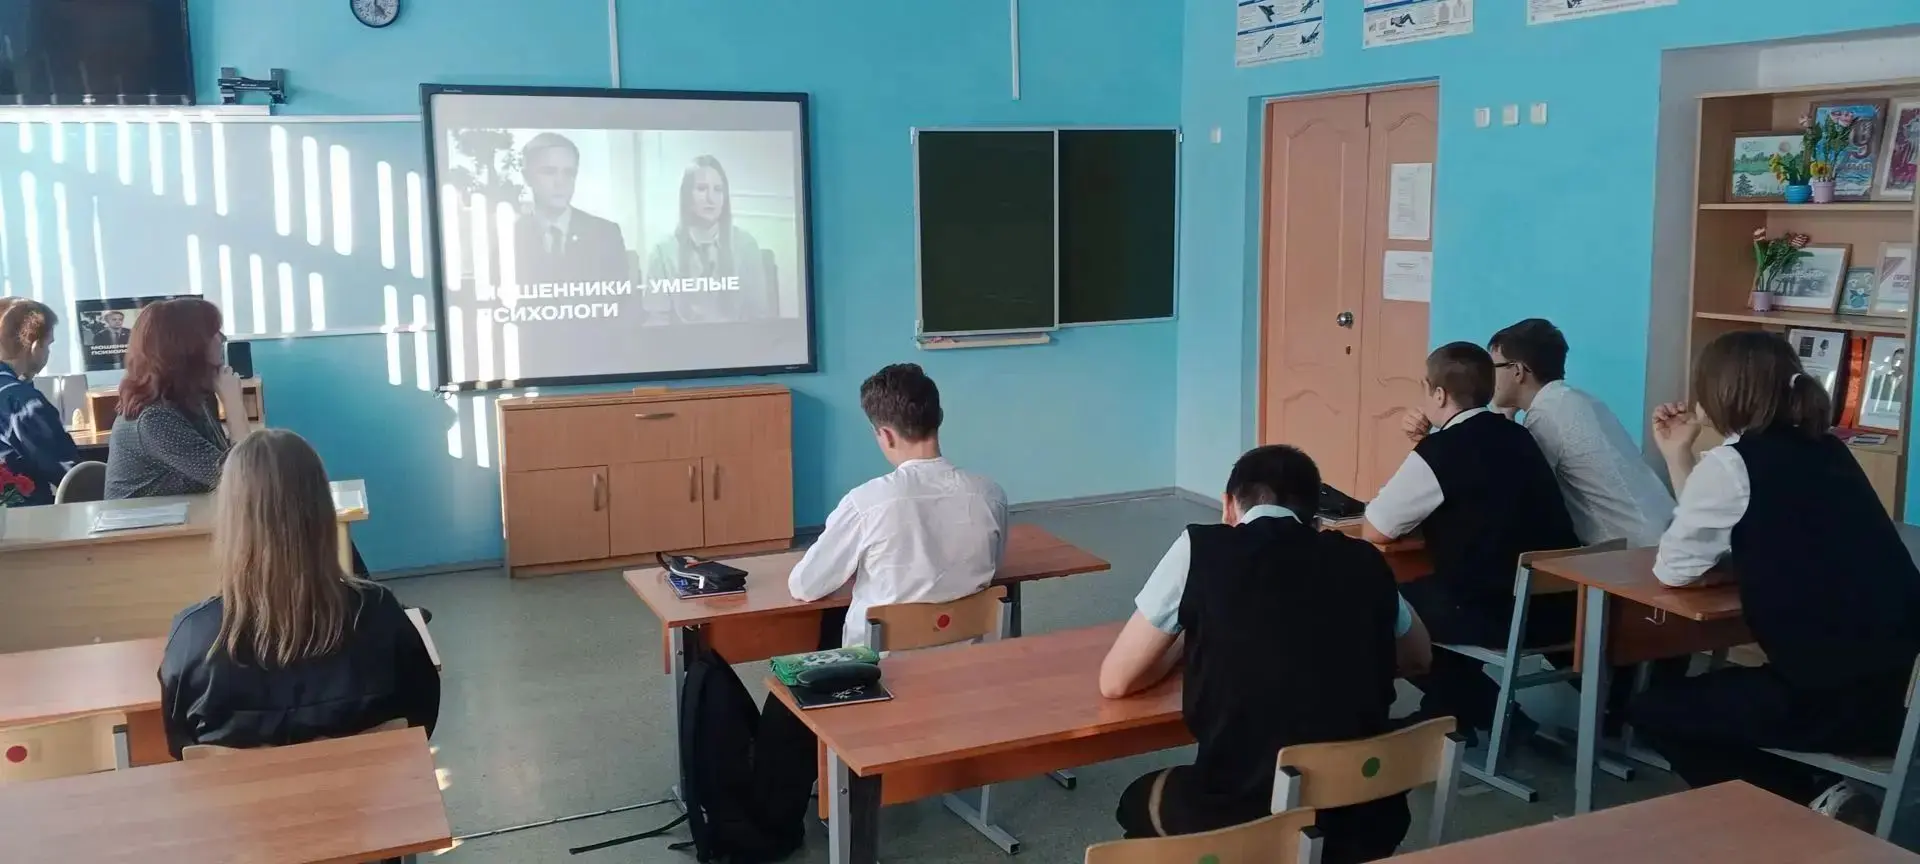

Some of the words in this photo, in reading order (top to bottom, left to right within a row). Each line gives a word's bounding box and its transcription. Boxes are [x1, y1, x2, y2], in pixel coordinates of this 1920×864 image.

[477, 281, 632, 300] ШЕННИКИ
[650, 276, 740, 294] УМЕЛЫЕ
[478, 303, 619, 322] СИХОЛОГИ
